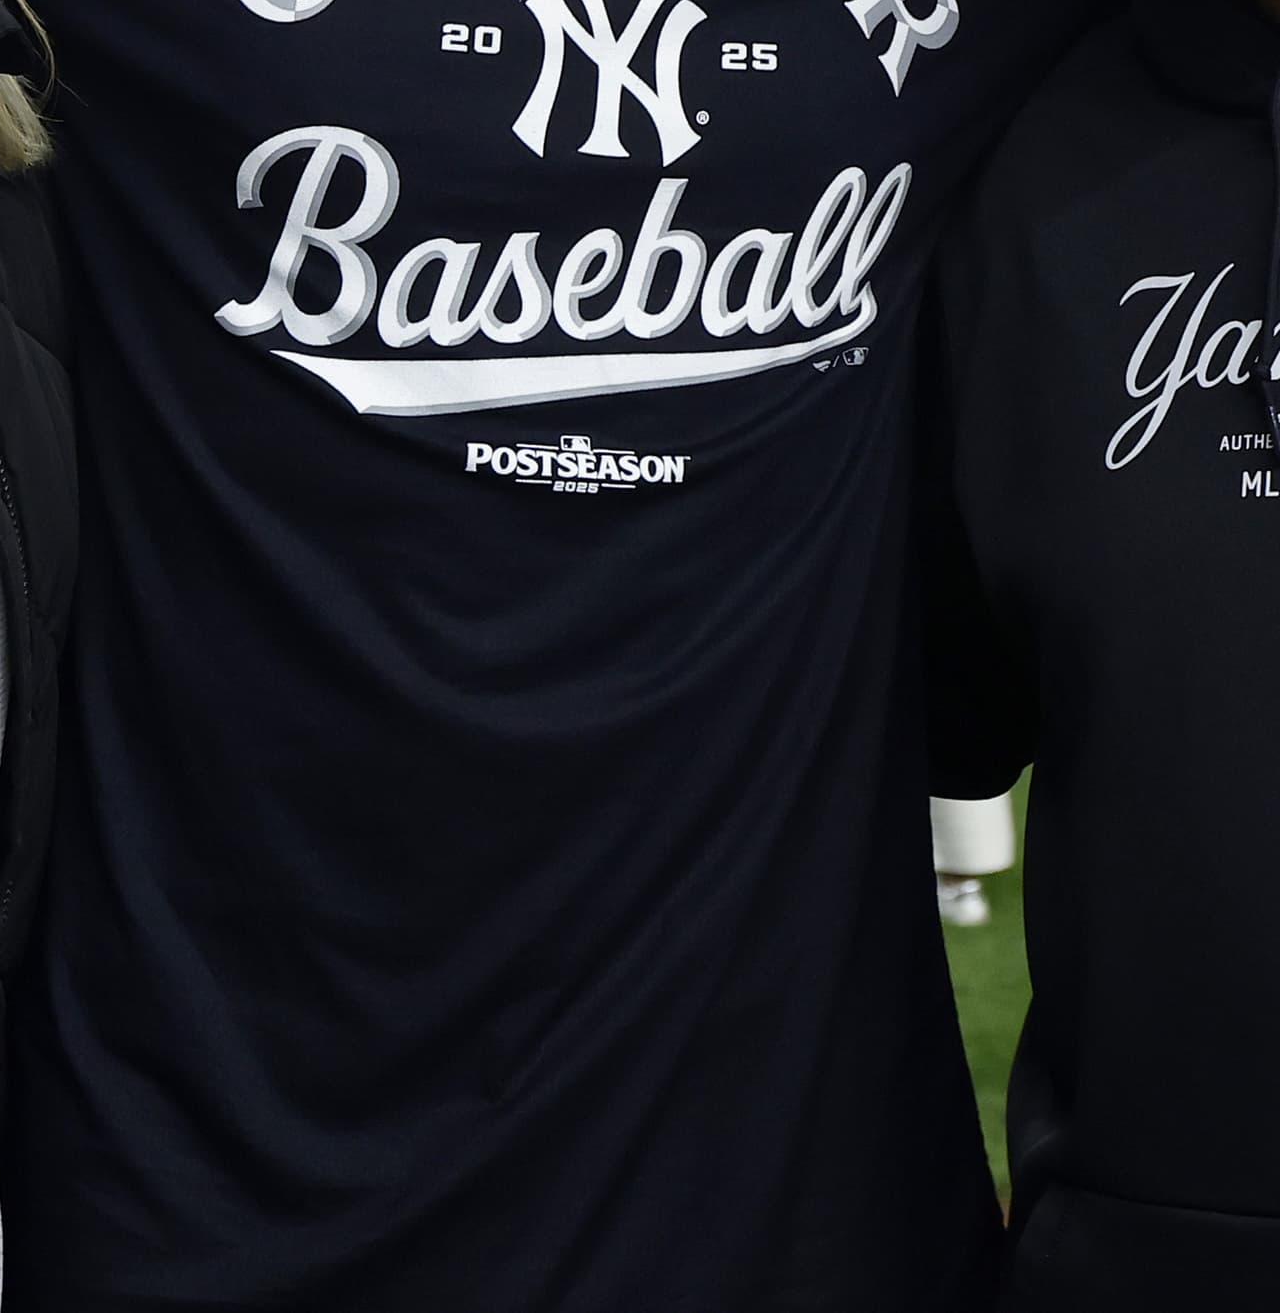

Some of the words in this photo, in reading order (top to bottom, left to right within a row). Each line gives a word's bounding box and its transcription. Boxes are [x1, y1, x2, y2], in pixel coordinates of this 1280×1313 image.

[441, 23, 501, 55] 20
[720, 42, 779, 72] 25
[214, 124, 912, 349] Baseball
[464, 442, 686, 484] POSTSEASON
[552, 481, 600, 494] 2025
